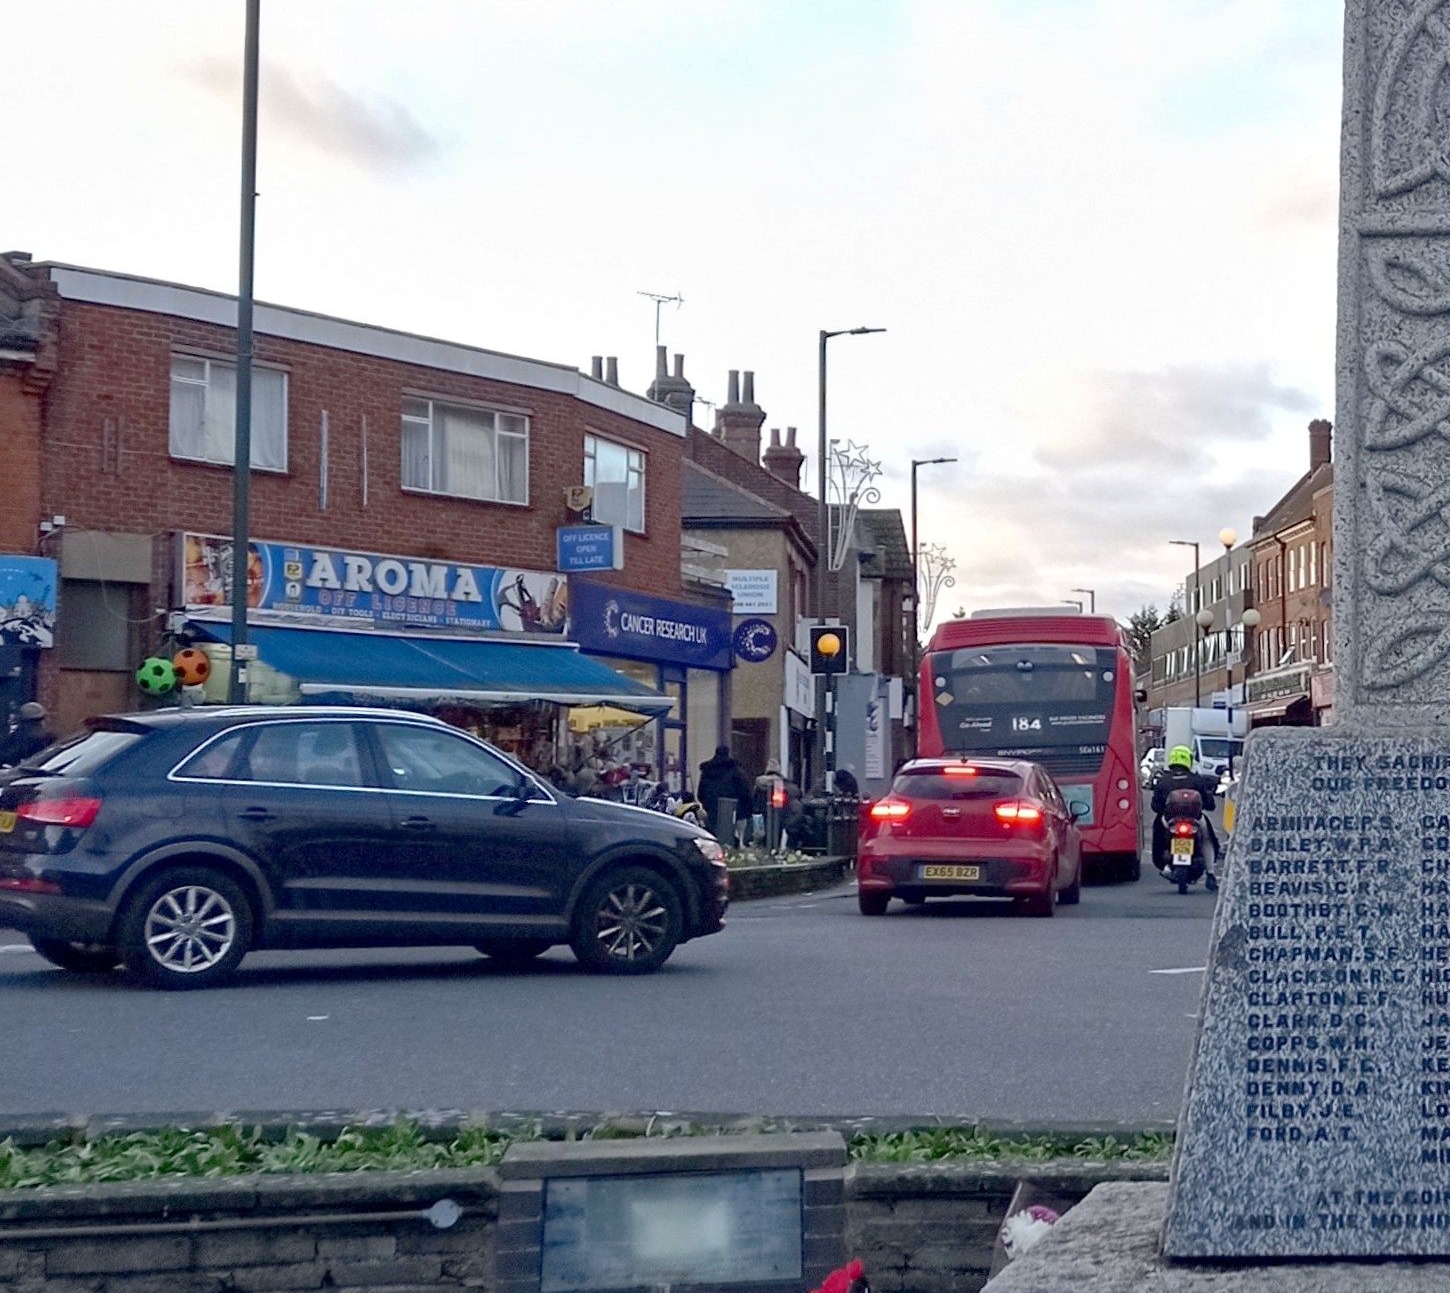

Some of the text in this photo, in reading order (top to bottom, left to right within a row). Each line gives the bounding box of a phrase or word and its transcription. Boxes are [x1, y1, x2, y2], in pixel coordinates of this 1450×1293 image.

[562, 532, 610, 542] OFF LICENCE
[576, 545, 597, 553] OPEN
[569, 555, 604, 565] TILL LATE
[305, 552, 482, 602] AROMA
[318, 590, 457, 615] OFF LICENCE
[348, 608, 374, 618] TOOLS
[621, 612, 707, 644] CANCER RESEARCH UK
[1012, 717, 1042, 731] 184
[1313, 755, 1367, 771] THEY
[1312, 776, 1356, 791] OUR
[925, 866, 978, 877] EX65 BZR
[1317, 1191, 1344, 1206] AT
[1354, 1191, 1395, 1205] THE
[1234, 1214, 1275, 1229] AND
[1286, 1214, 1306, 1229] IN
[1317, 1214, 1358, 1229] THE
